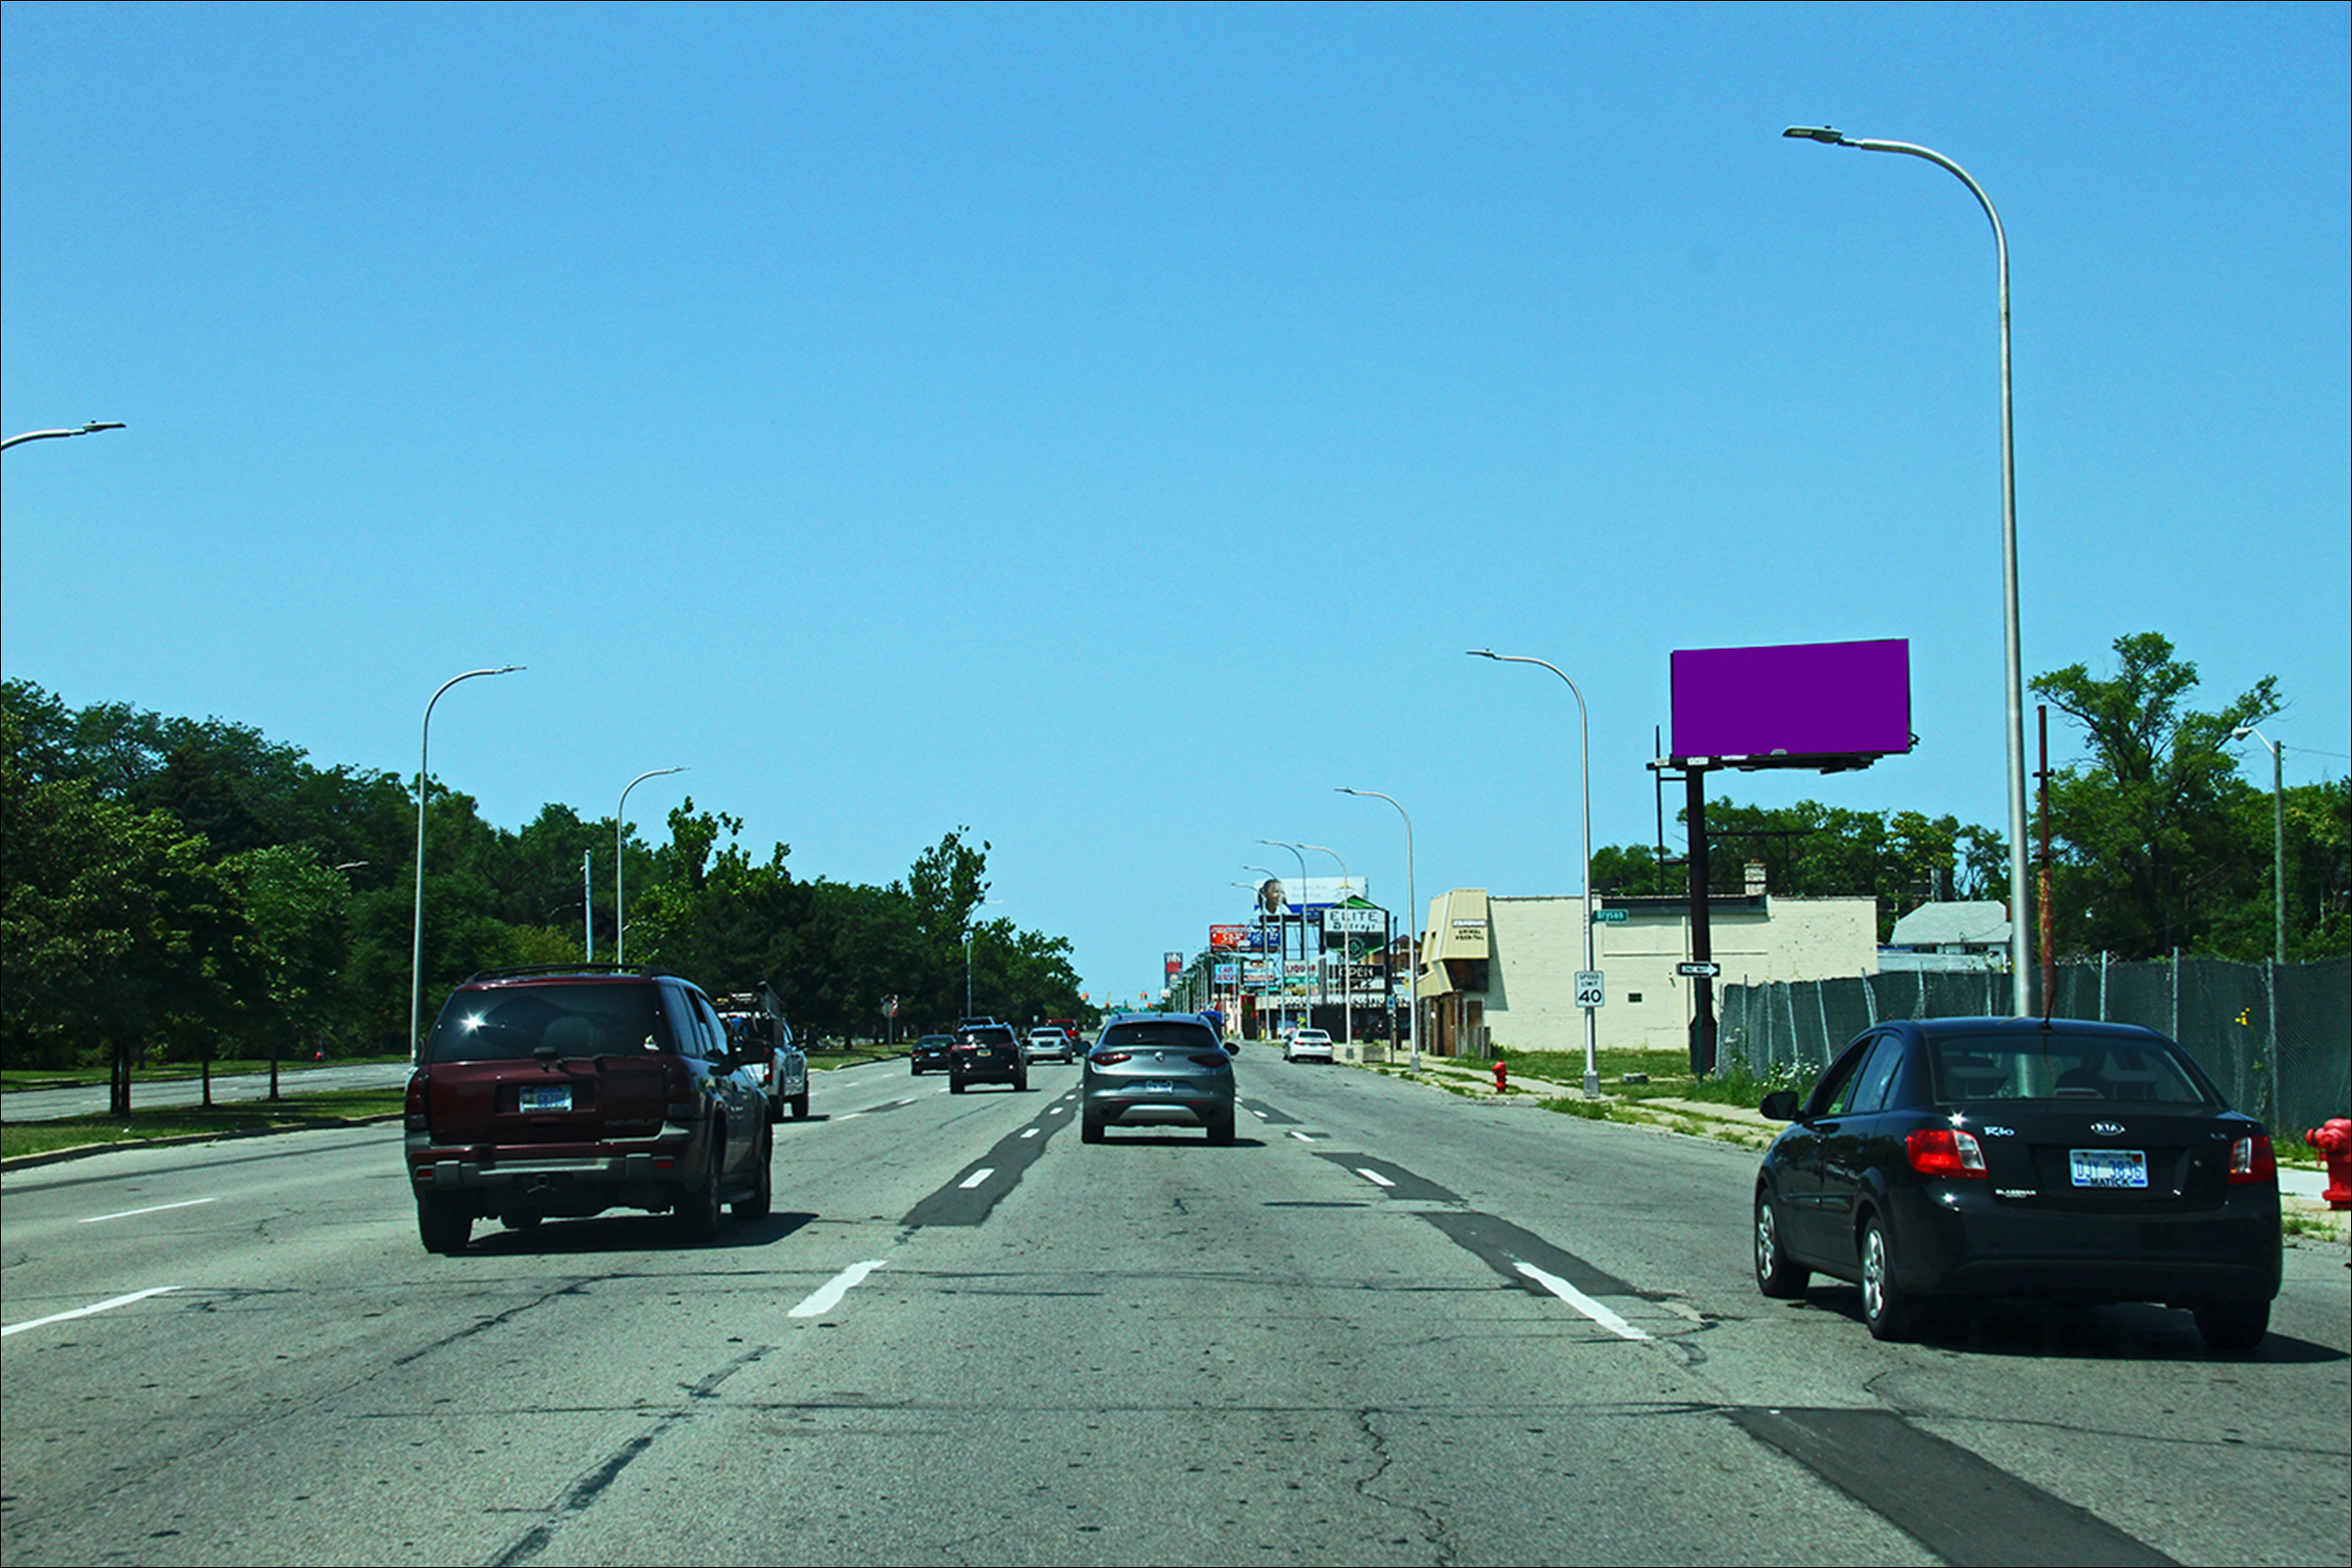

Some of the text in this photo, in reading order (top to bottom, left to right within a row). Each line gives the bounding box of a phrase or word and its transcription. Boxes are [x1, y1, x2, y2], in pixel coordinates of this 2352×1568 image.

[1330, 910, 1378, 922] ELITE
[1596, 909, 1625, 921] Bryson
[1339, 966, 1374, 977] OPEN
[1579, 989, 1601, 1003] 40
[604, 1118, 662, 1127] CHEVROLET
[2096, 1123, 2119, 1132] KIA
[1984, 1126, 2015, 1137] Rio
[2089, 1178, 2131, 1187] MATICK
